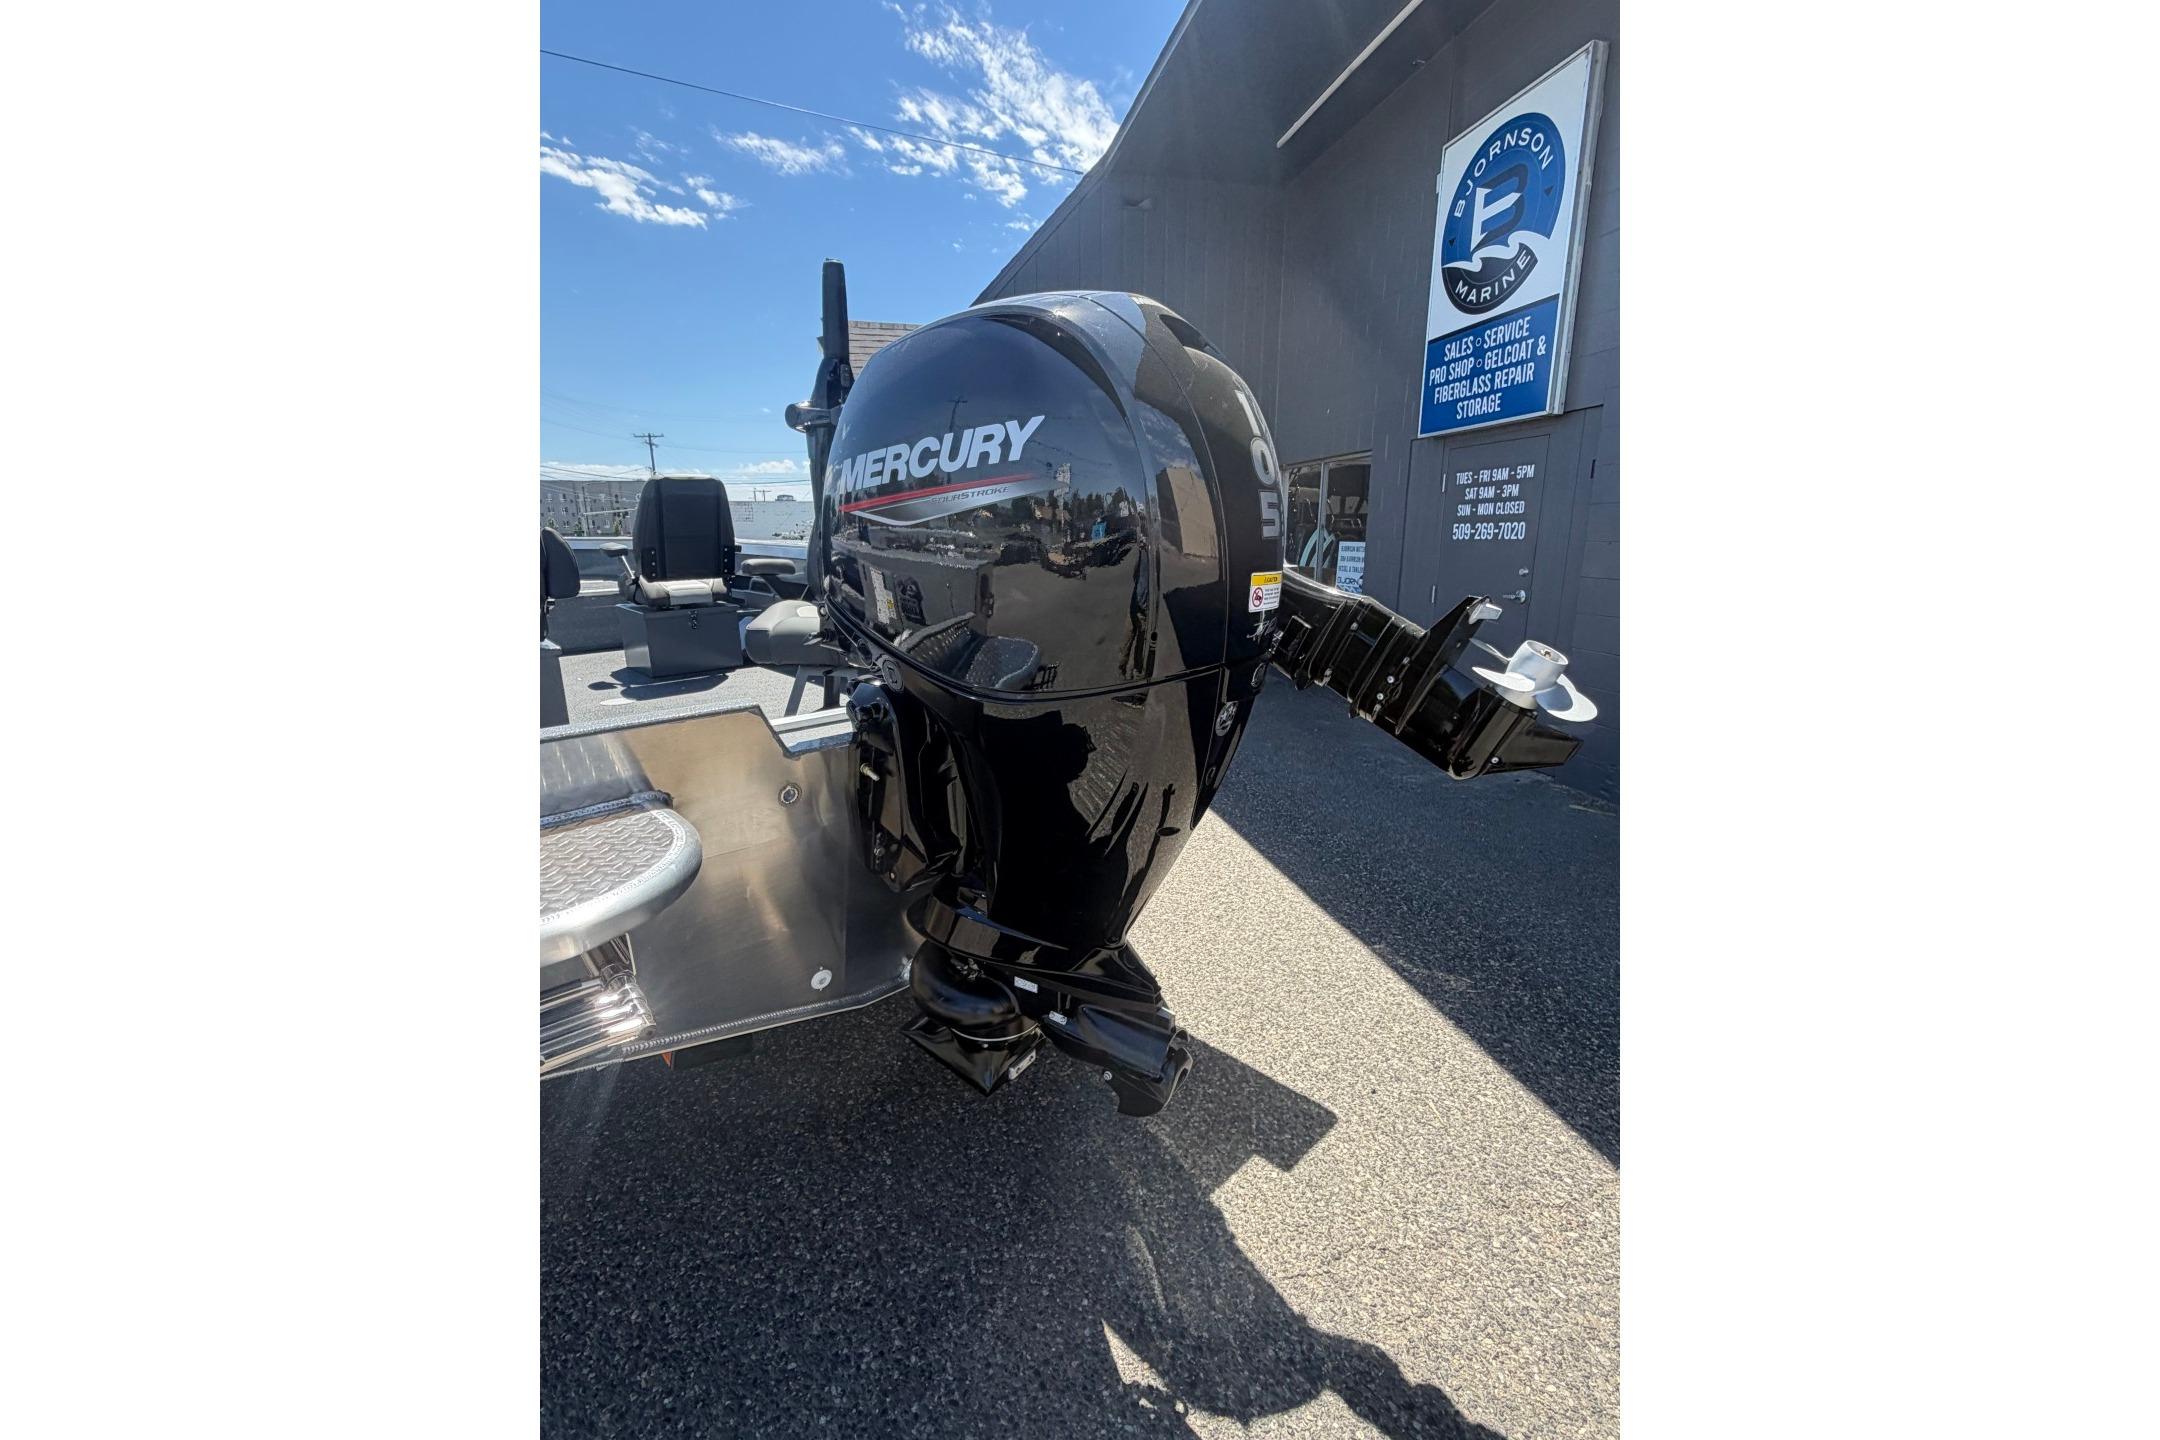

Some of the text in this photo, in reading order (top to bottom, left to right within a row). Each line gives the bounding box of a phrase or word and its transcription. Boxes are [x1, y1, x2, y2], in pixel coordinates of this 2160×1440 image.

[1453, 127, 1554, 218] BJORNSON
[1455, 249, 1531, 304] MARINE
[1444, 316, 1531, 361] SALES SERVICE
[1429, 335, 1547, 386] PRO SHOP GELCOAT &
[1434, 362, 1535, 404] FIBERGLASS REPAIR
[1456, 392, 1502, 420] STORAGE
[839, 415, 1045, 494] MERCURY
[1456, 472, 1473, 485] TUES
[1478, 469, 1491, 483] FRI
[1491, 467, 1509, 481] 9AM
[1516, 464, 1535, 479] 5PM
[1457, 504, 1471, 517] SUN
[1477, 502, 1495, 516] MON
[1495, 501, 1525, 515] CLOSED
[1464, 487, 1479, 500] SAT
[1478, 485, 1495, 499] 9AM
[1501, 483, 1520, 498] 3PM
[1452, 521, 1526, 540] 509-269-7020
